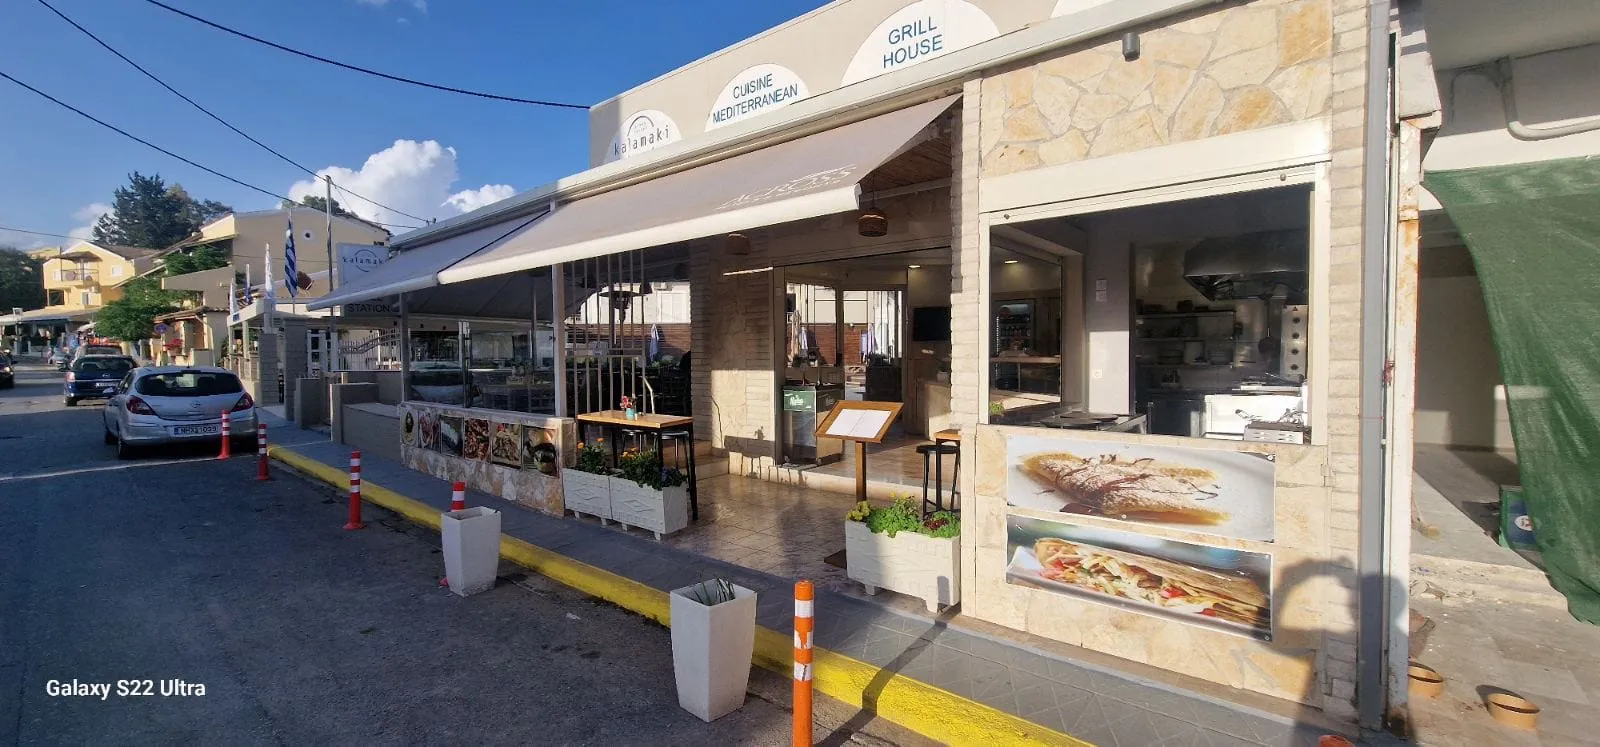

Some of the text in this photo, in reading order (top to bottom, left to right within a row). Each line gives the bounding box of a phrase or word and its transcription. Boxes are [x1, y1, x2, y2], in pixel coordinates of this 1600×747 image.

[888, 15, 938, 45] GRILL
[883, 34, 943, 68] HOUSE
[733, 73, 773, 99] CUISINE
[712, 83, 798, 124] MEDITERRANEAN
[614, 124, 669, 156] kalamaki
[347, 303, 390, 313] STATION
